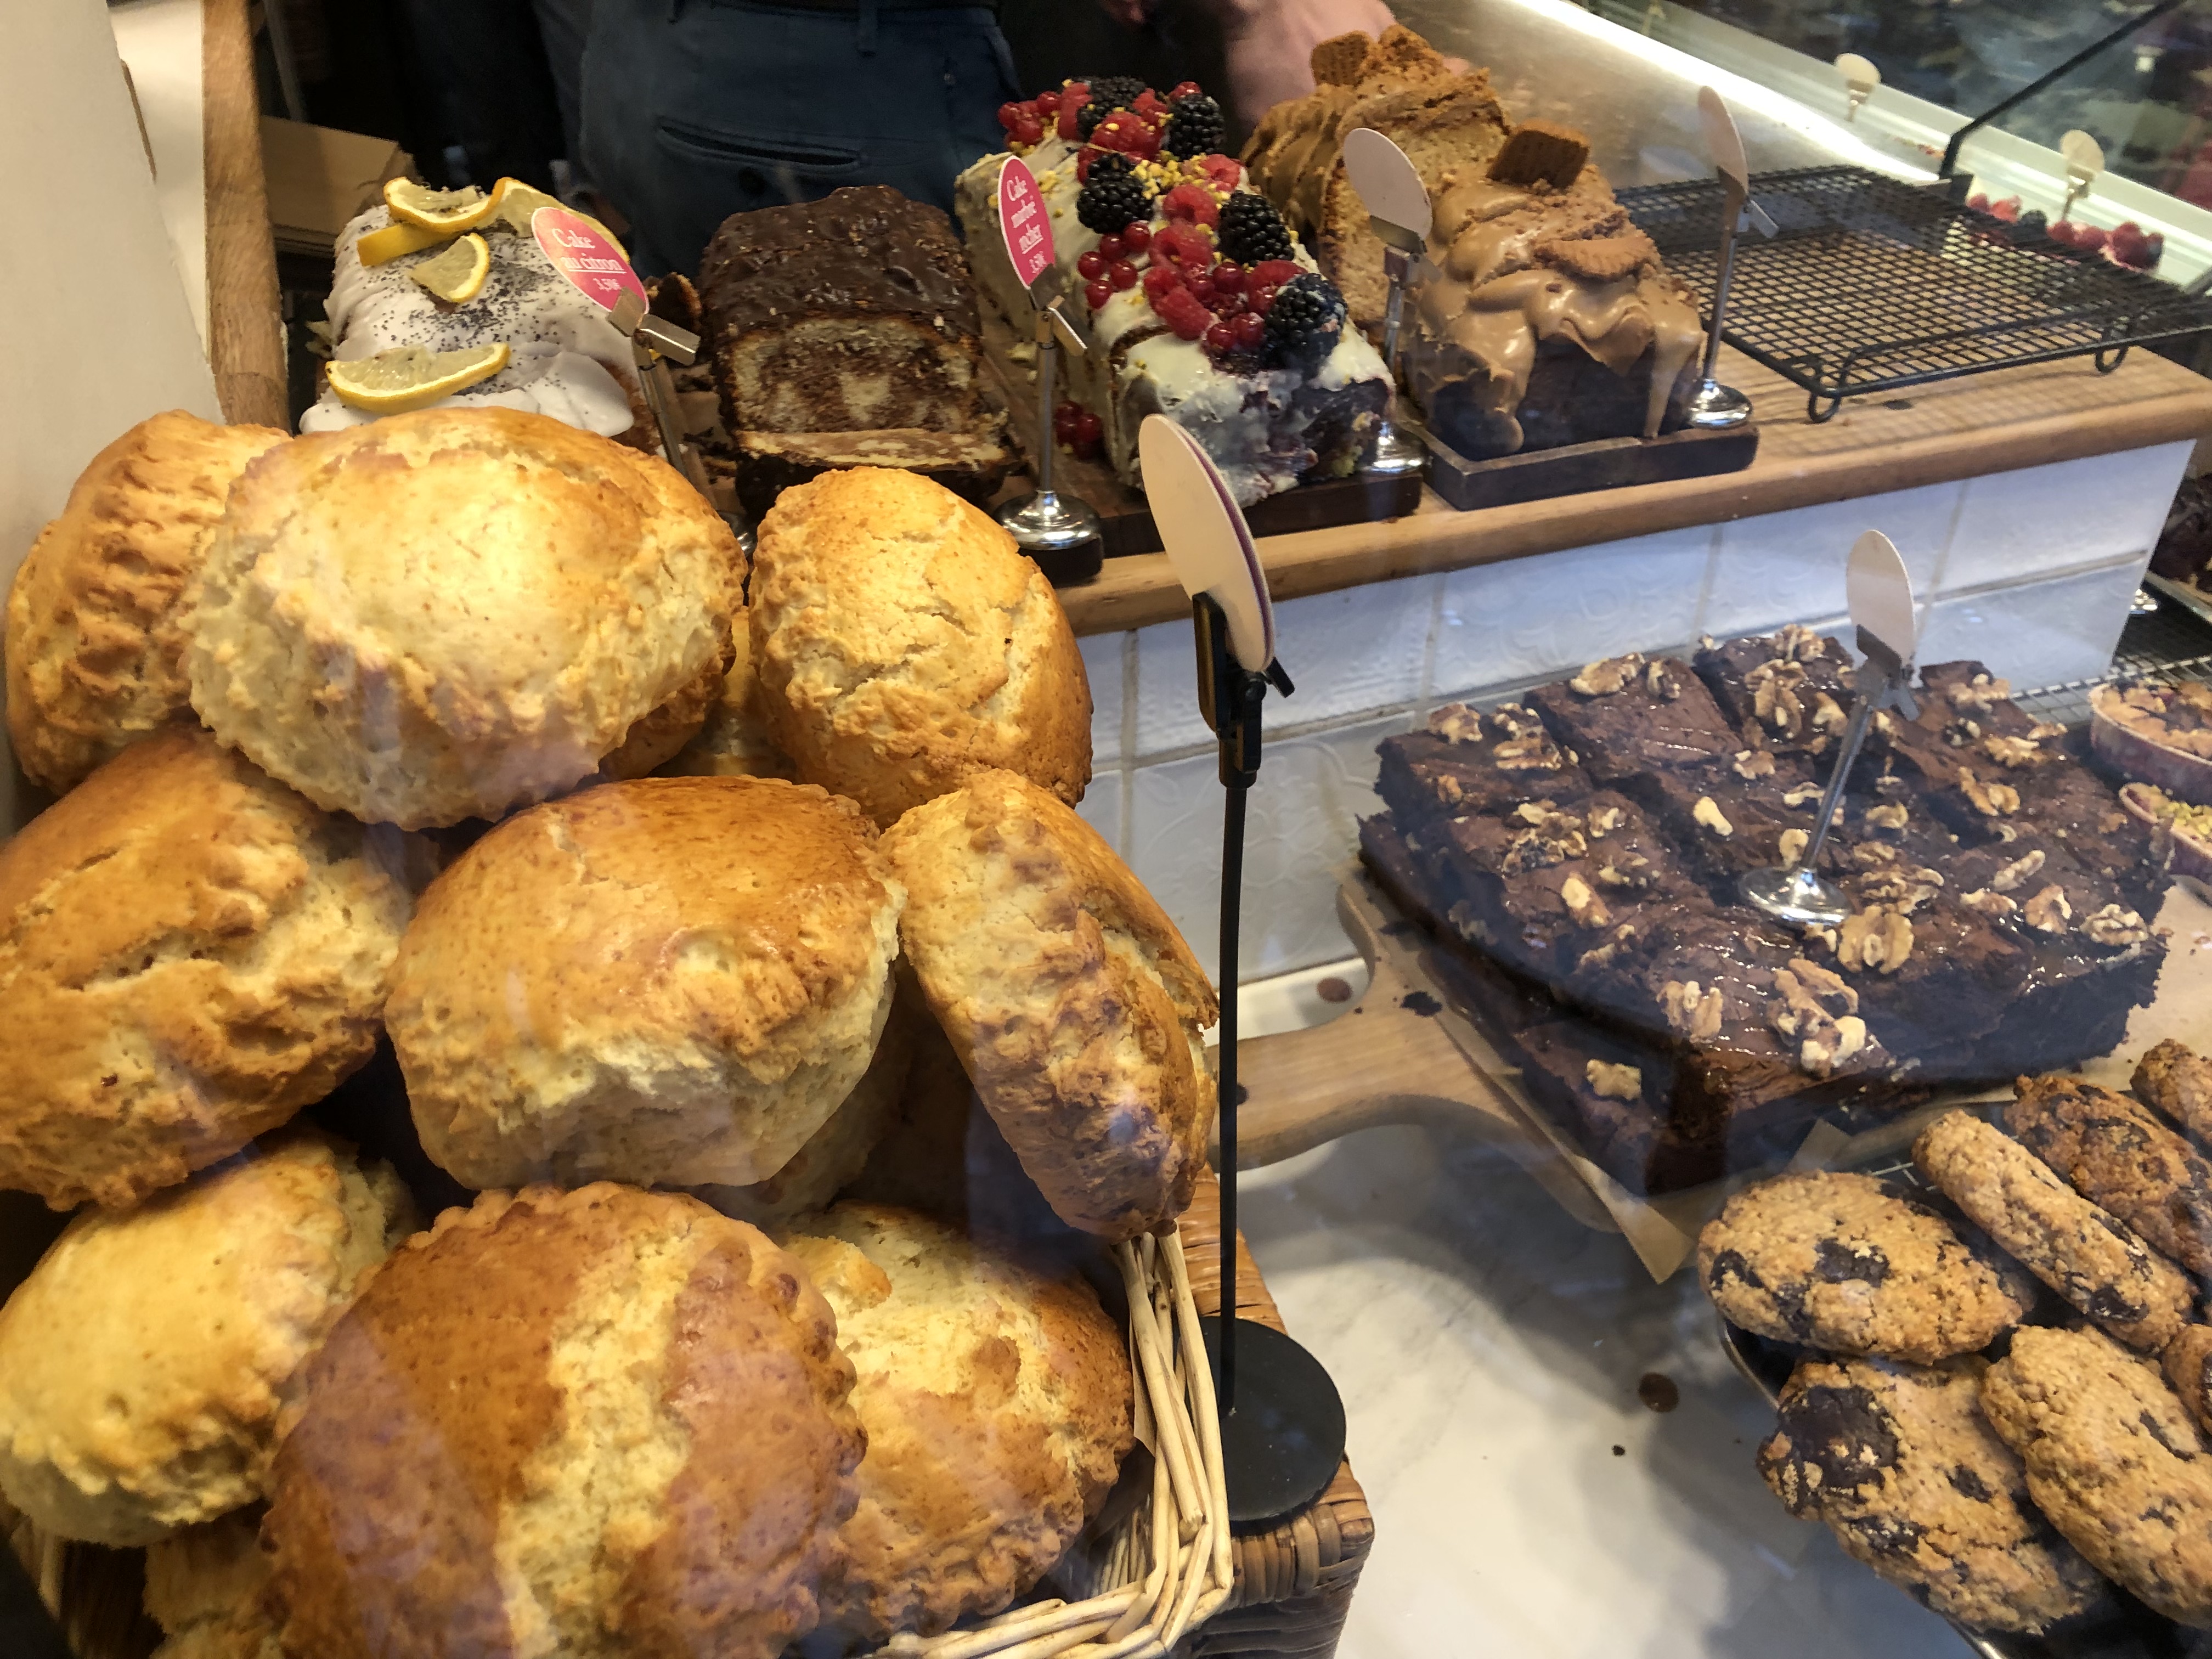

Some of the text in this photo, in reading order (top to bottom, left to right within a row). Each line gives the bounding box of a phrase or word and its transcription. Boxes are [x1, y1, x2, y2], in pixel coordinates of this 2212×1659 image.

[1006, 176, 1028, 201] Cake
[551, 228, 596, 249] Cake
[559, 252, 625, 271] au citron
